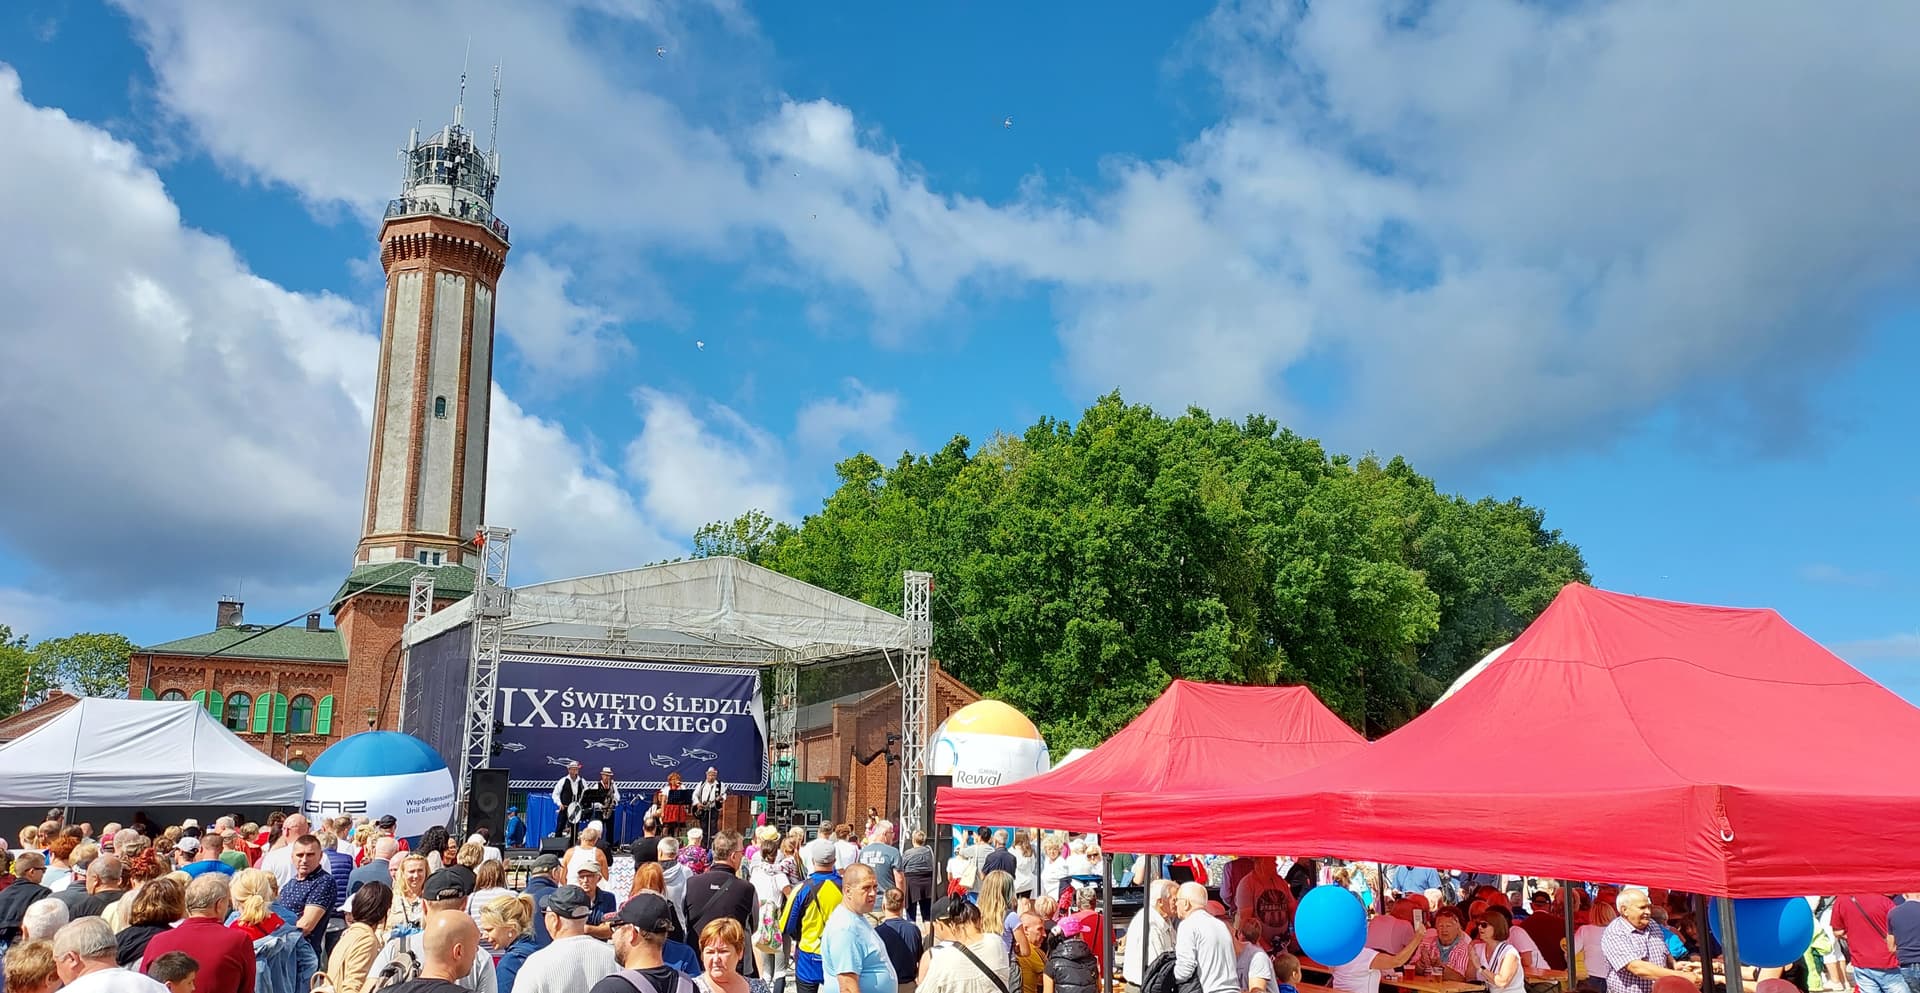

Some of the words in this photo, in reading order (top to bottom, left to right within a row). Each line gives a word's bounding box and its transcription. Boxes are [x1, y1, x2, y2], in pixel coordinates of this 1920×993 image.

[499, 687, 558, 728] IX
[561, 687, 656, 714] ŚWIĘTO
[662, 692, 753, 716] ŚLEDZIA
[560, 711, 727, 734] BAŁTYCKIEGO
[957, 770, 1001, 785] Rewal
